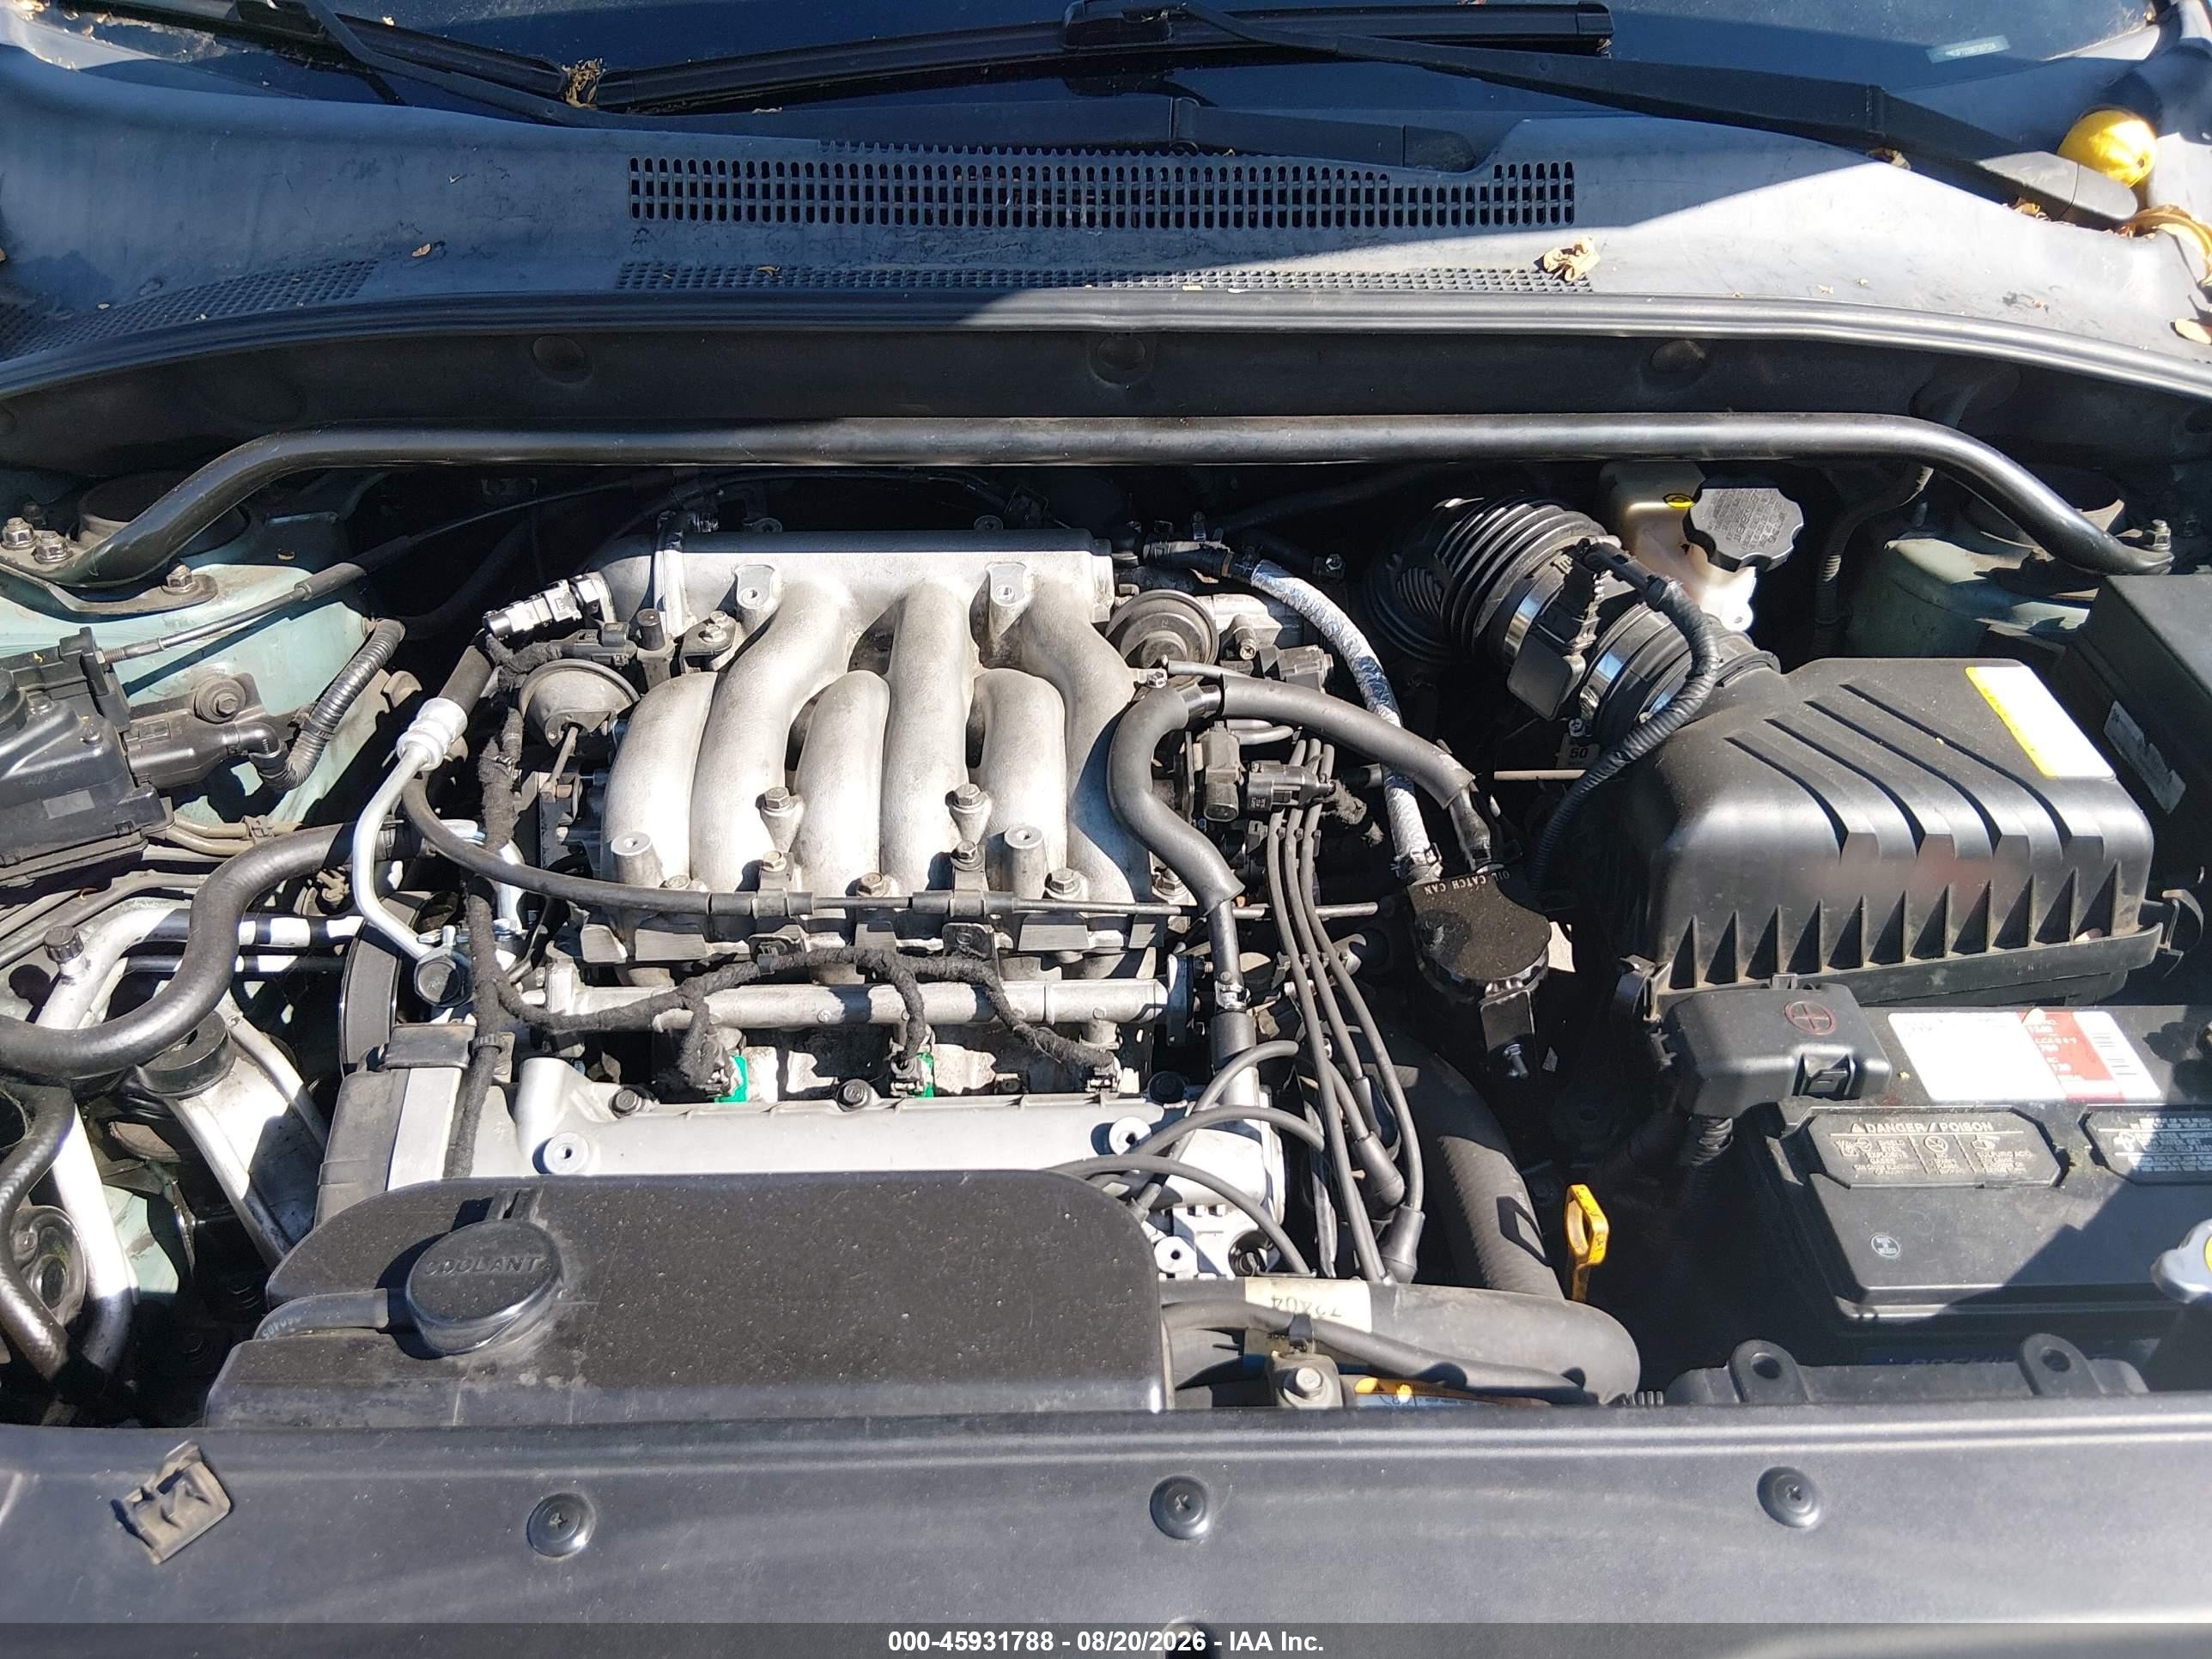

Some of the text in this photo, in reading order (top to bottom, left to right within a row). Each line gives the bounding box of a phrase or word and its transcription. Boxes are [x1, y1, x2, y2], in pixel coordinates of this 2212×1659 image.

[1424, 871, 1510, 895] OIL CATCH CAN
[1865, 1123, 1925, 1133] DANGER
[1940, 1122, 1994, 1133] POISON
[426, 1256, 546, 1276] COOLANT
